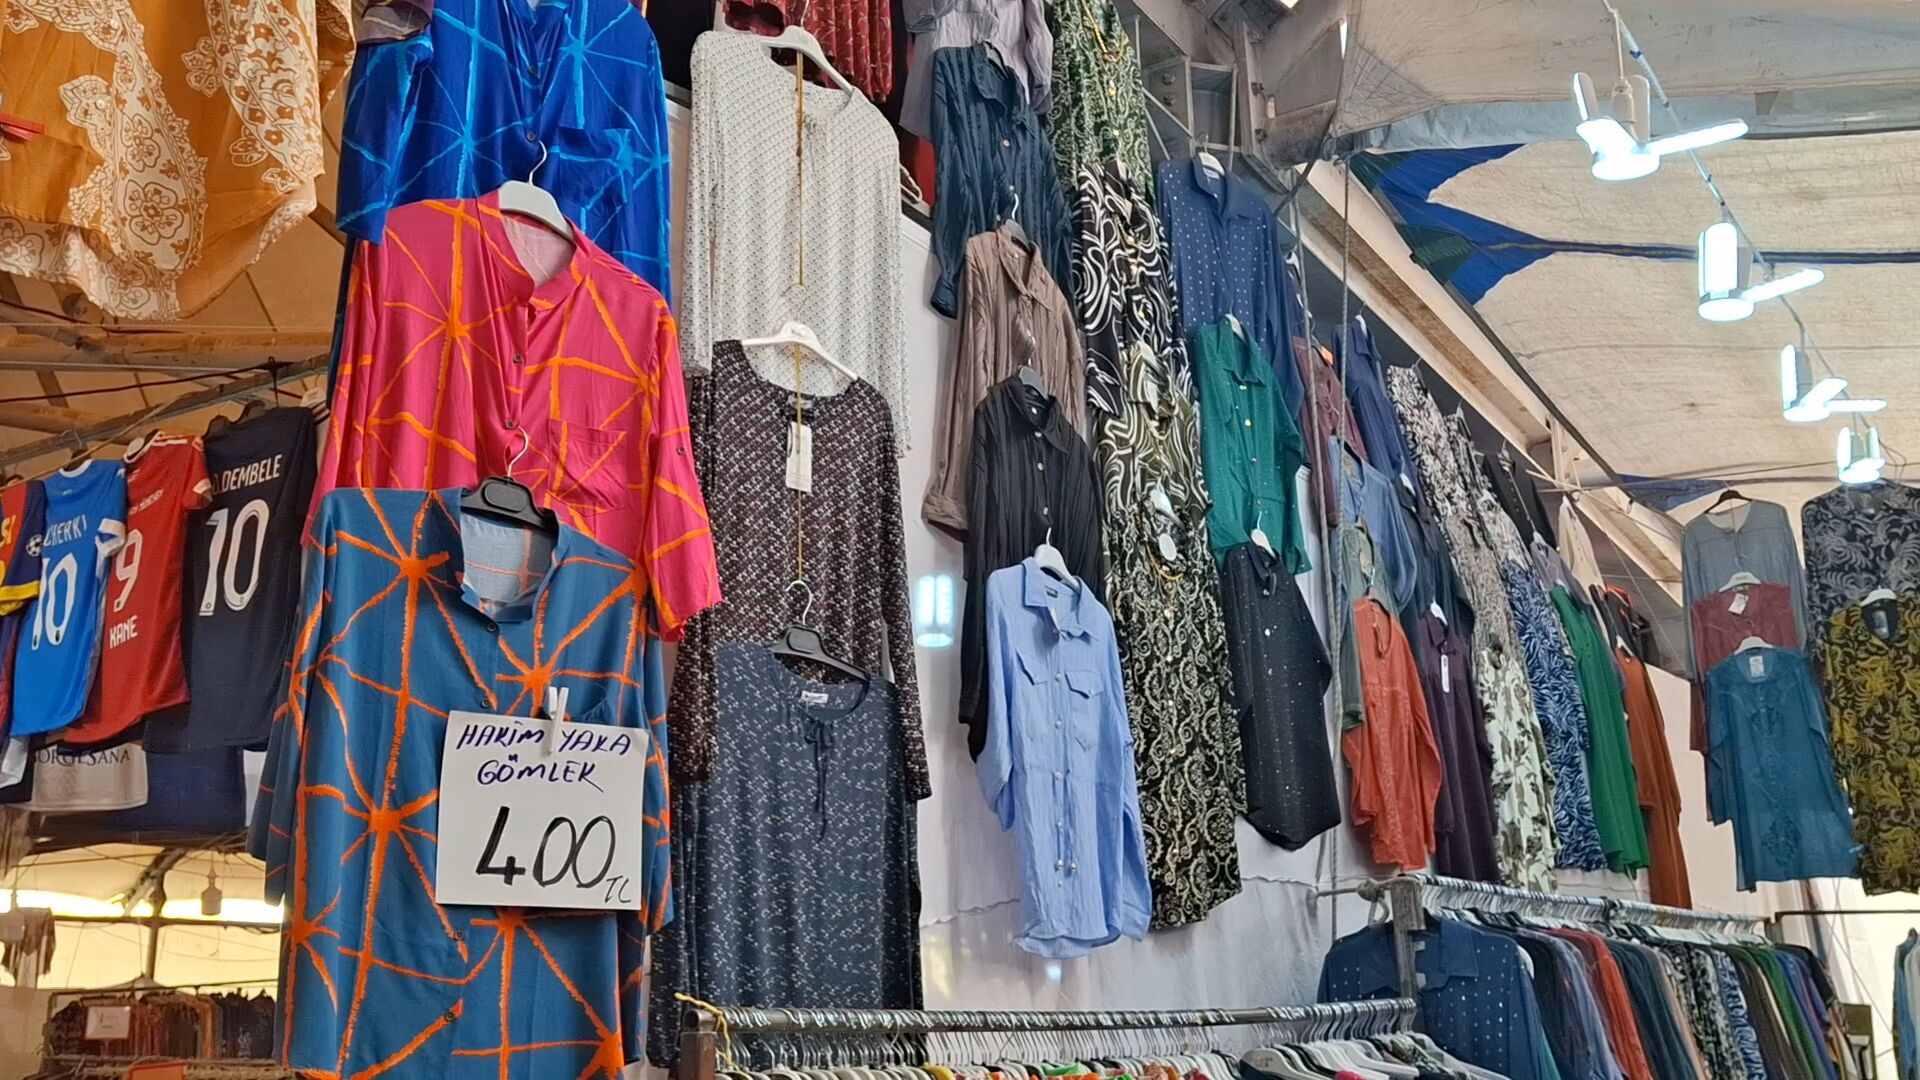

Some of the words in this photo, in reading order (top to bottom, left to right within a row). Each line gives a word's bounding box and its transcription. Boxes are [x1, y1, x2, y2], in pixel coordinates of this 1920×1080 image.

[113, 528, 143, 613] 9
[199, 498, 270, 616] 10
[32, 552, 78, 651] 10
[109, 614, 139, 649] KANE
[477, 753, 604, 793] GÖMLEK
[558, 729, 632, 756] YAKA
[476, 805, 616, 889] 400
